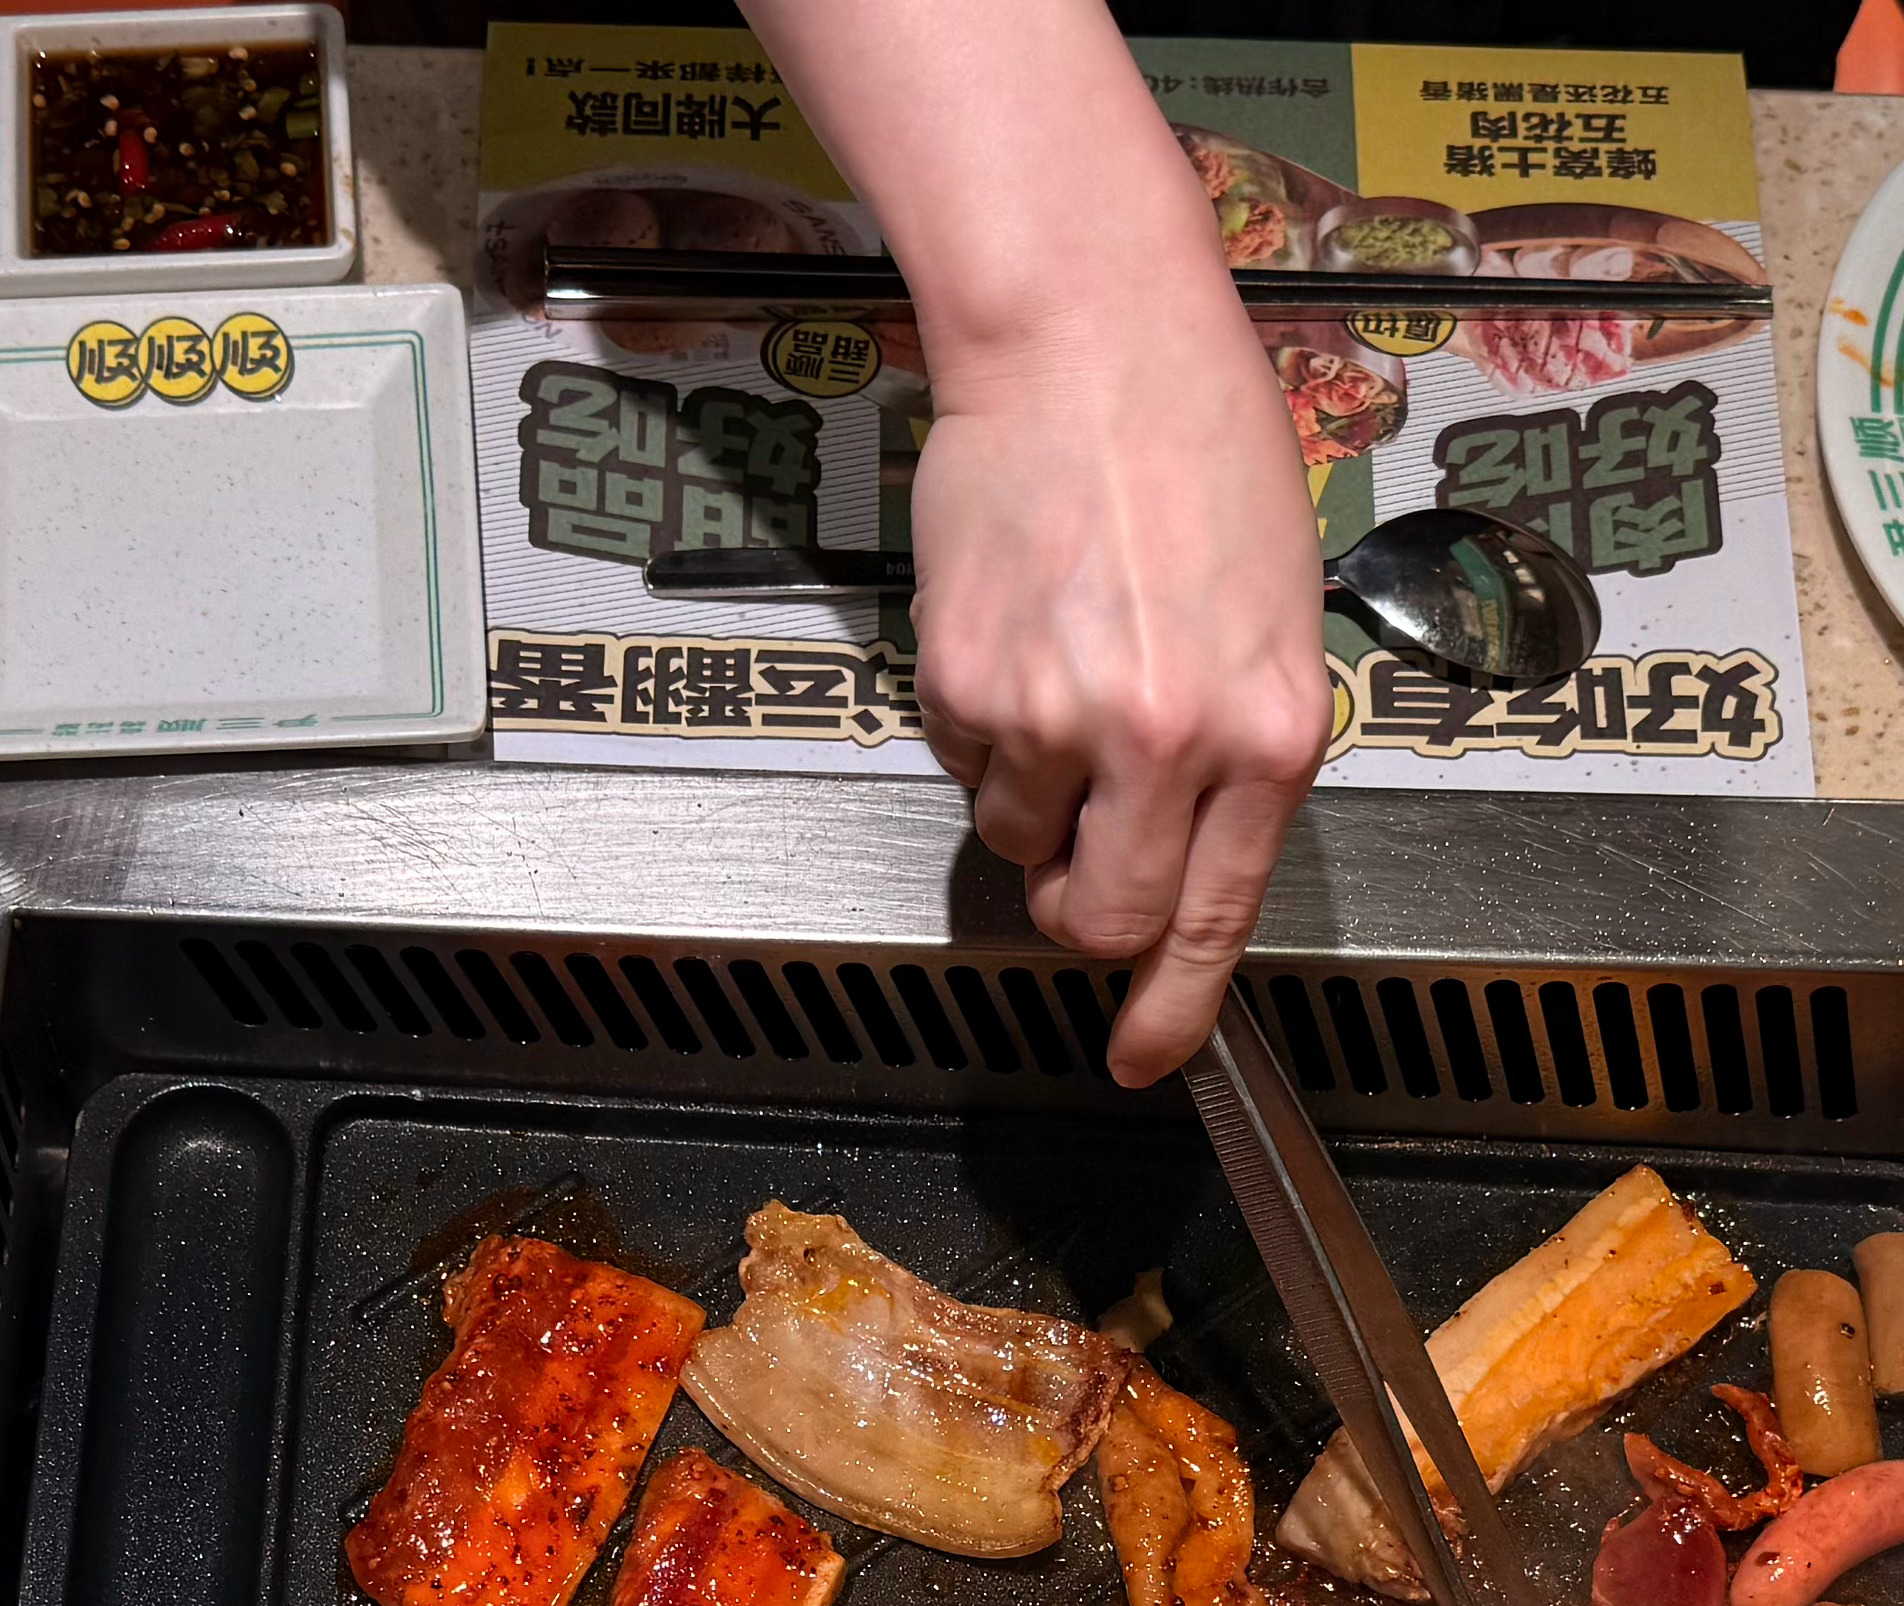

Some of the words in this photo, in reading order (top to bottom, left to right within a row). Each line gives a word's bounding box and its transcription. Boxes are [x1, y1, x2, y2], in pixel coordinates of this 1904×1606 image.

[566, 89, 782, 141] 大牌同款
[1417, 80, 1670, 105] 五花还是黑猪香
[1470, 111, 1627, 144] 五花肉
[1443, 144, 1657, 181] 蜂窝土猪
[536, 372, 813, 495] 好吃
[1445, 396, 1709, 507] 好吃
[1527, 479, 1709, 571] 肉
[1360, 658, 1766, 747] 好吃有
